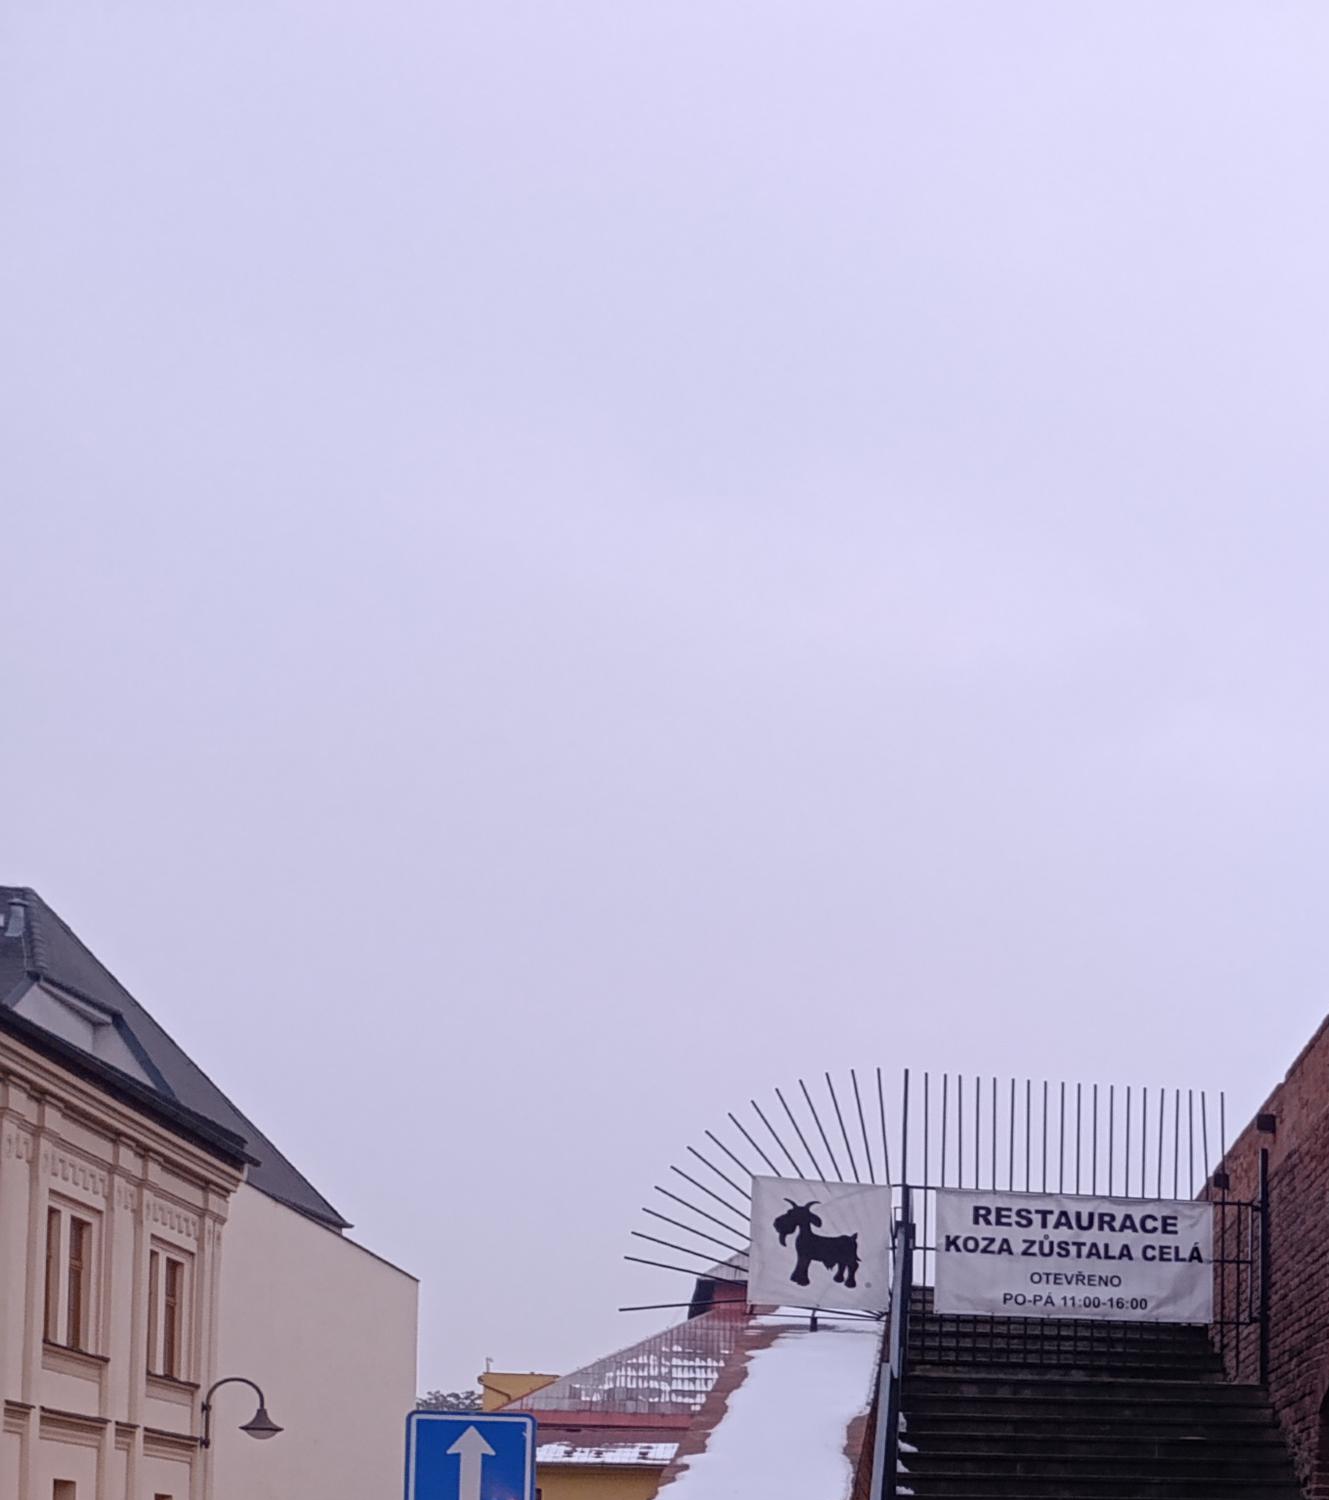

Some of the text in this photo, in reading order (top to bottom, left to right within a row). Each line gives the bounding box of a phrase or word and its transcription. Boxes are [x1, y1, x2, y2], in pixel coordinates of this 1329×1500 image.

[972, 1205, 1179, 1235] RESTAURACE
[944, 1233, 1204, 1264] KOZA ZŮSTALA CELÁ
[1030, 1270, 1122, 1288] OTEVŘENO
[1003, 1292, 1148, 1310] PO-PÁ 11:00-16:00
